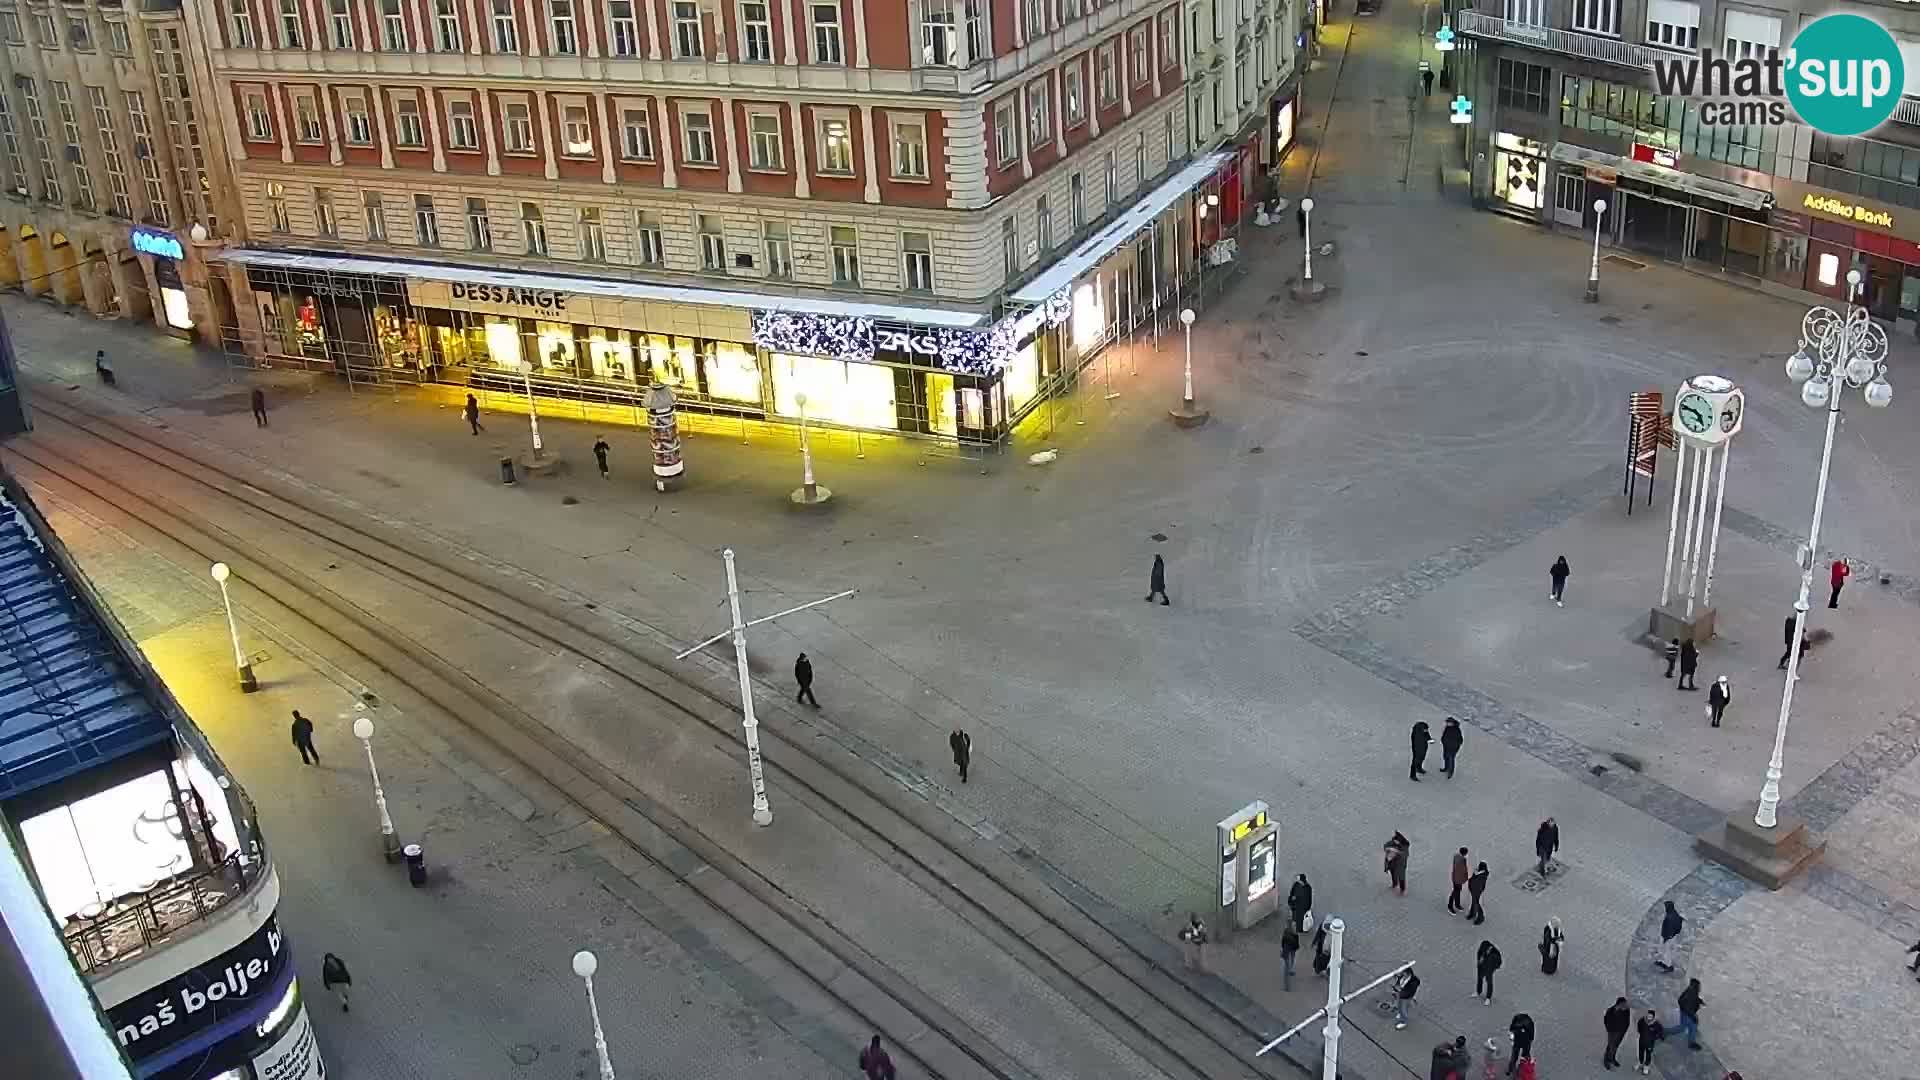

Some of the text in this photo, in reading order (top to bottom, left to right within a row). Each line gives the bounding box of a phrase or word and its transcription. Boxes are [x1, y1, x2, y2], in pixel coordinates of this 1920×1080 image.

[1804, 193, 1893, 228] Addiko Bank
[452, 282, 565, 310] DESSANGE
[876, 330, 939, 355] ZAKS
[116, 998, 176, 1047] naš
[181, 958, 269, 1014] bolje,
